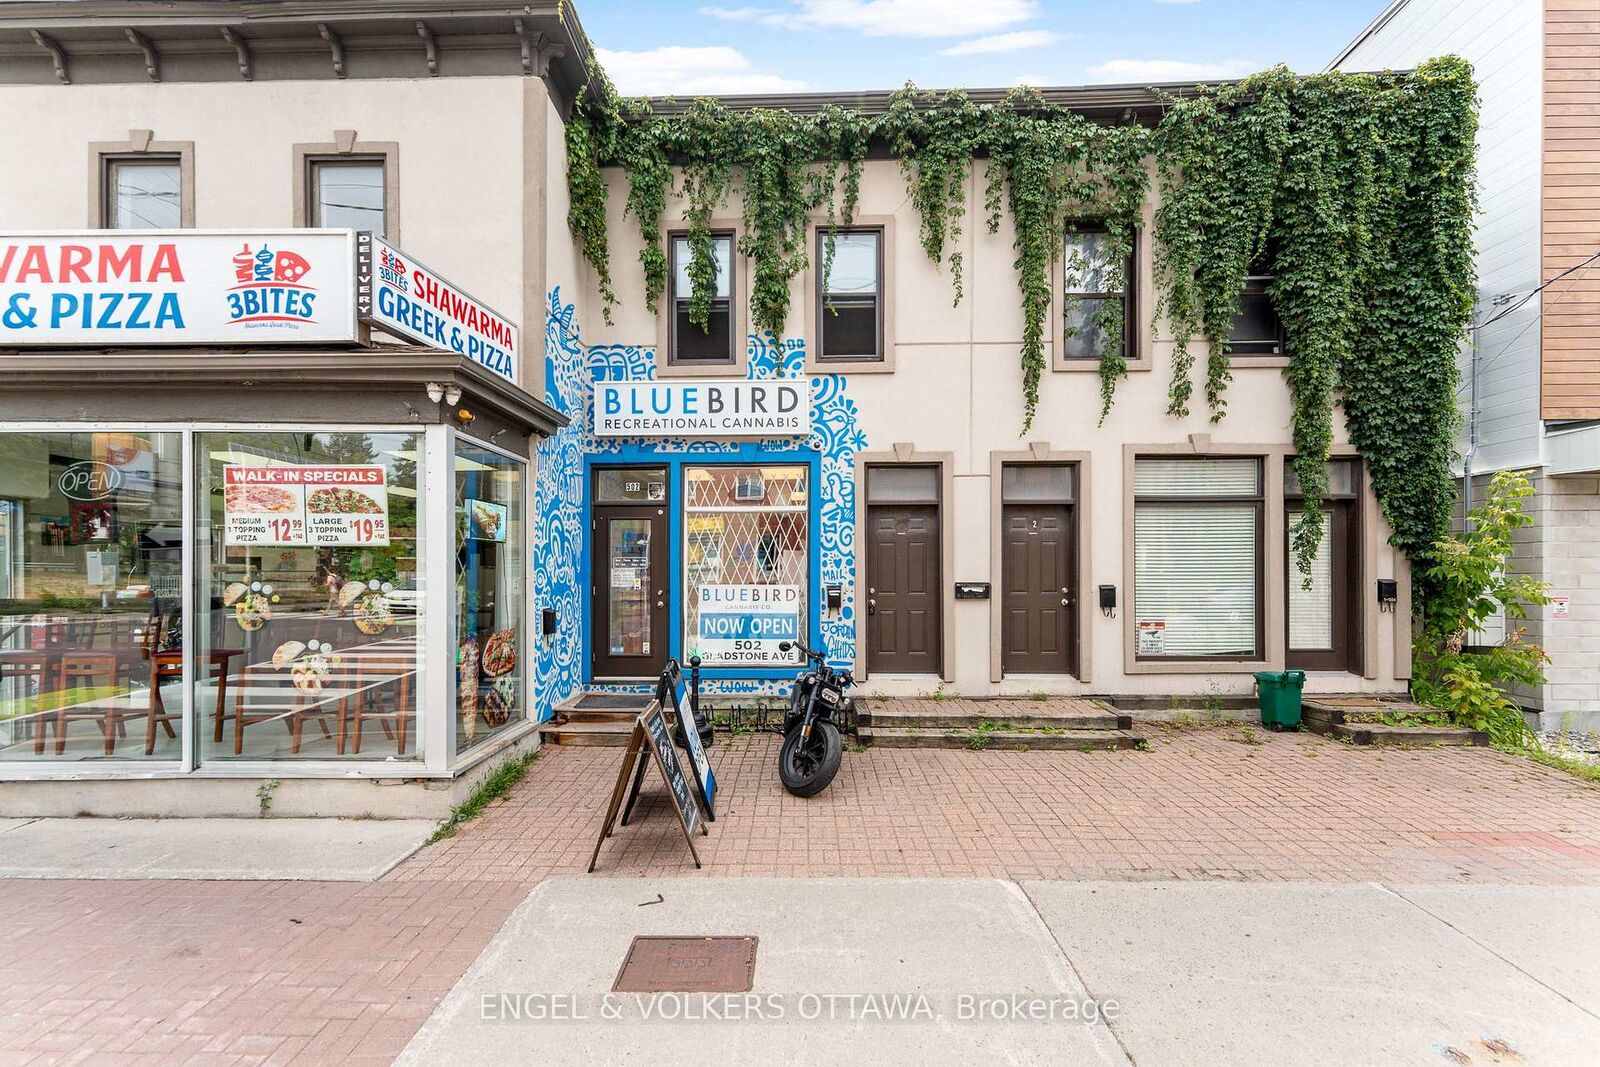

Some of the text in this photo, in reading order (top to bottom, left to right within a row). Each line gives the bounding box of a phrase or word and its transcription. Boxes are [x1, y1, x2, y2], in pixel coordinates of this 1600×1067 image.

[357, 235, 372, 314] DELIVERY
[378, 266, 409, 292] 3BITES
[2, 292, 186, 329] & PIZZA
[226, 288, 316, 319] 3BITES
[413, 270, 513, 351] SHAWARMA
[378, 286, 513, 379] GREEK & PIZZA
[604, 386, 799, 415] BLUEBIRD
[604, 417, 799, 429] RECREATIONAL CANNABIS
[62, 472, 115, 491] OPEN
[233, 470, 377, 482] WALK-IN SPECIALS
[626, 483, 640, 491] 502
[234, 526, 266, 534] TOPPING
[315, 526, 348, 534] TOPPING
[1032, 520, 1037, 529] 2
[823, 569, 846, 581] MAIL
[702, 588, 796, 602] BLUEBIRD
[704, 618, 793, 634] NOW OPEN
[734, 640, 762, 650] 502
[771, 652, 794, 661] AVE
